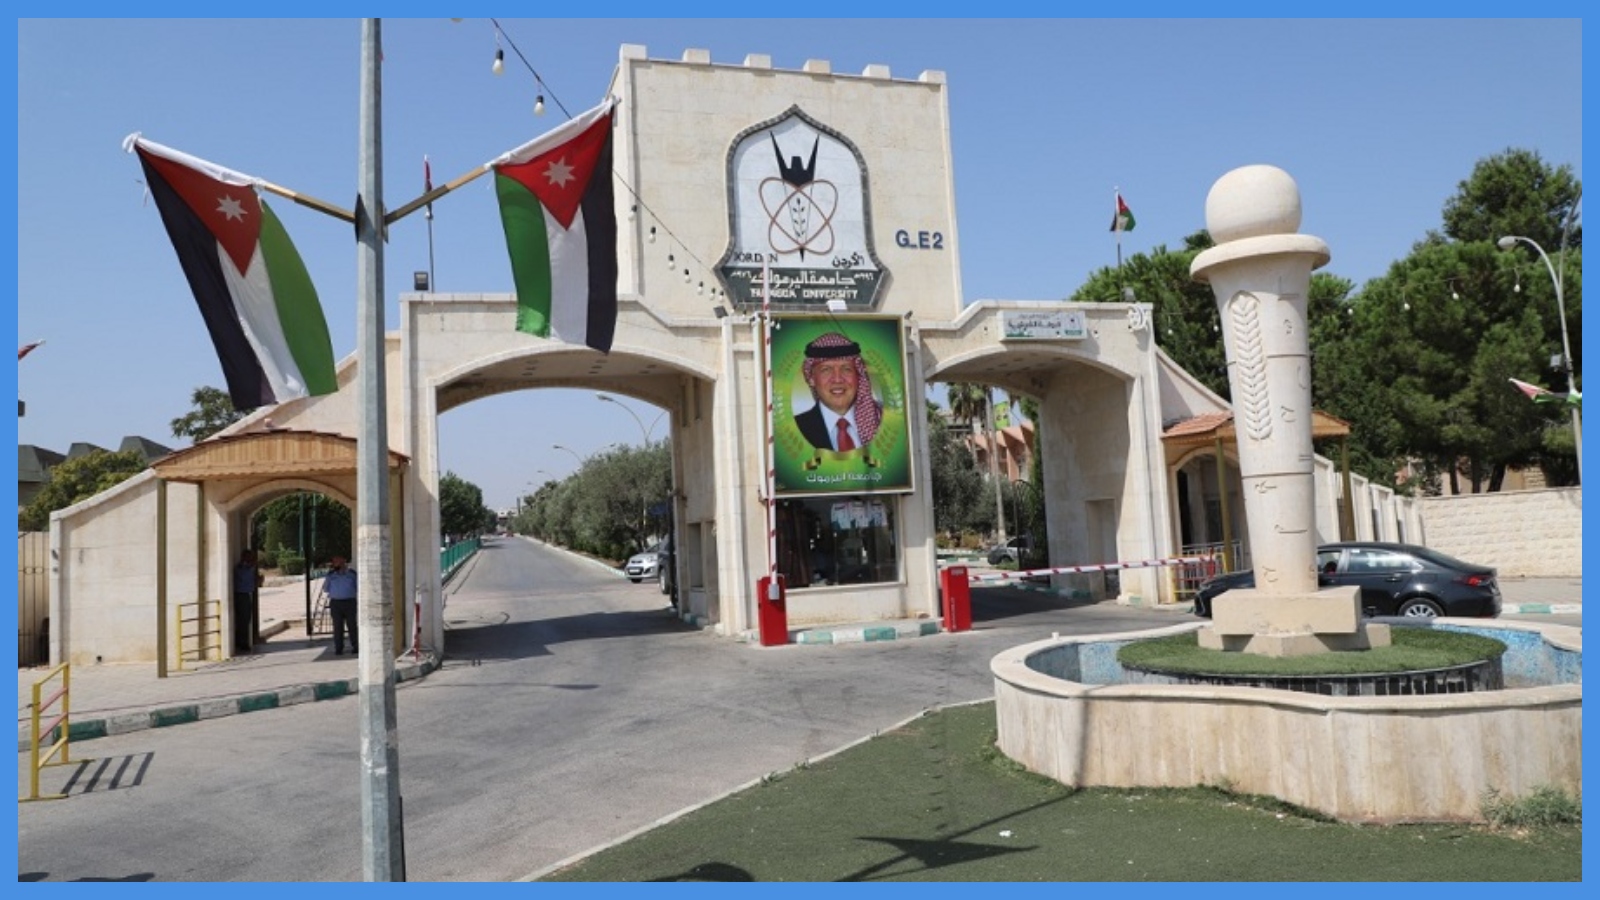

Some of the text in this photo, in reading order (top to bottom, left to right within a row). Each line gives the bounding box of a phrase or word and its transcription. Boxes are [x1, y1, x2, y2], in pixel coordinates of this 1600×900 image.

[733, 251, 778, 263] JORDN
[807, 270, 857, 289] جامعة
[802, 289, 858, 299] UNIVERSITY
[805, 471, 883, 484] جامعة اليرموك
